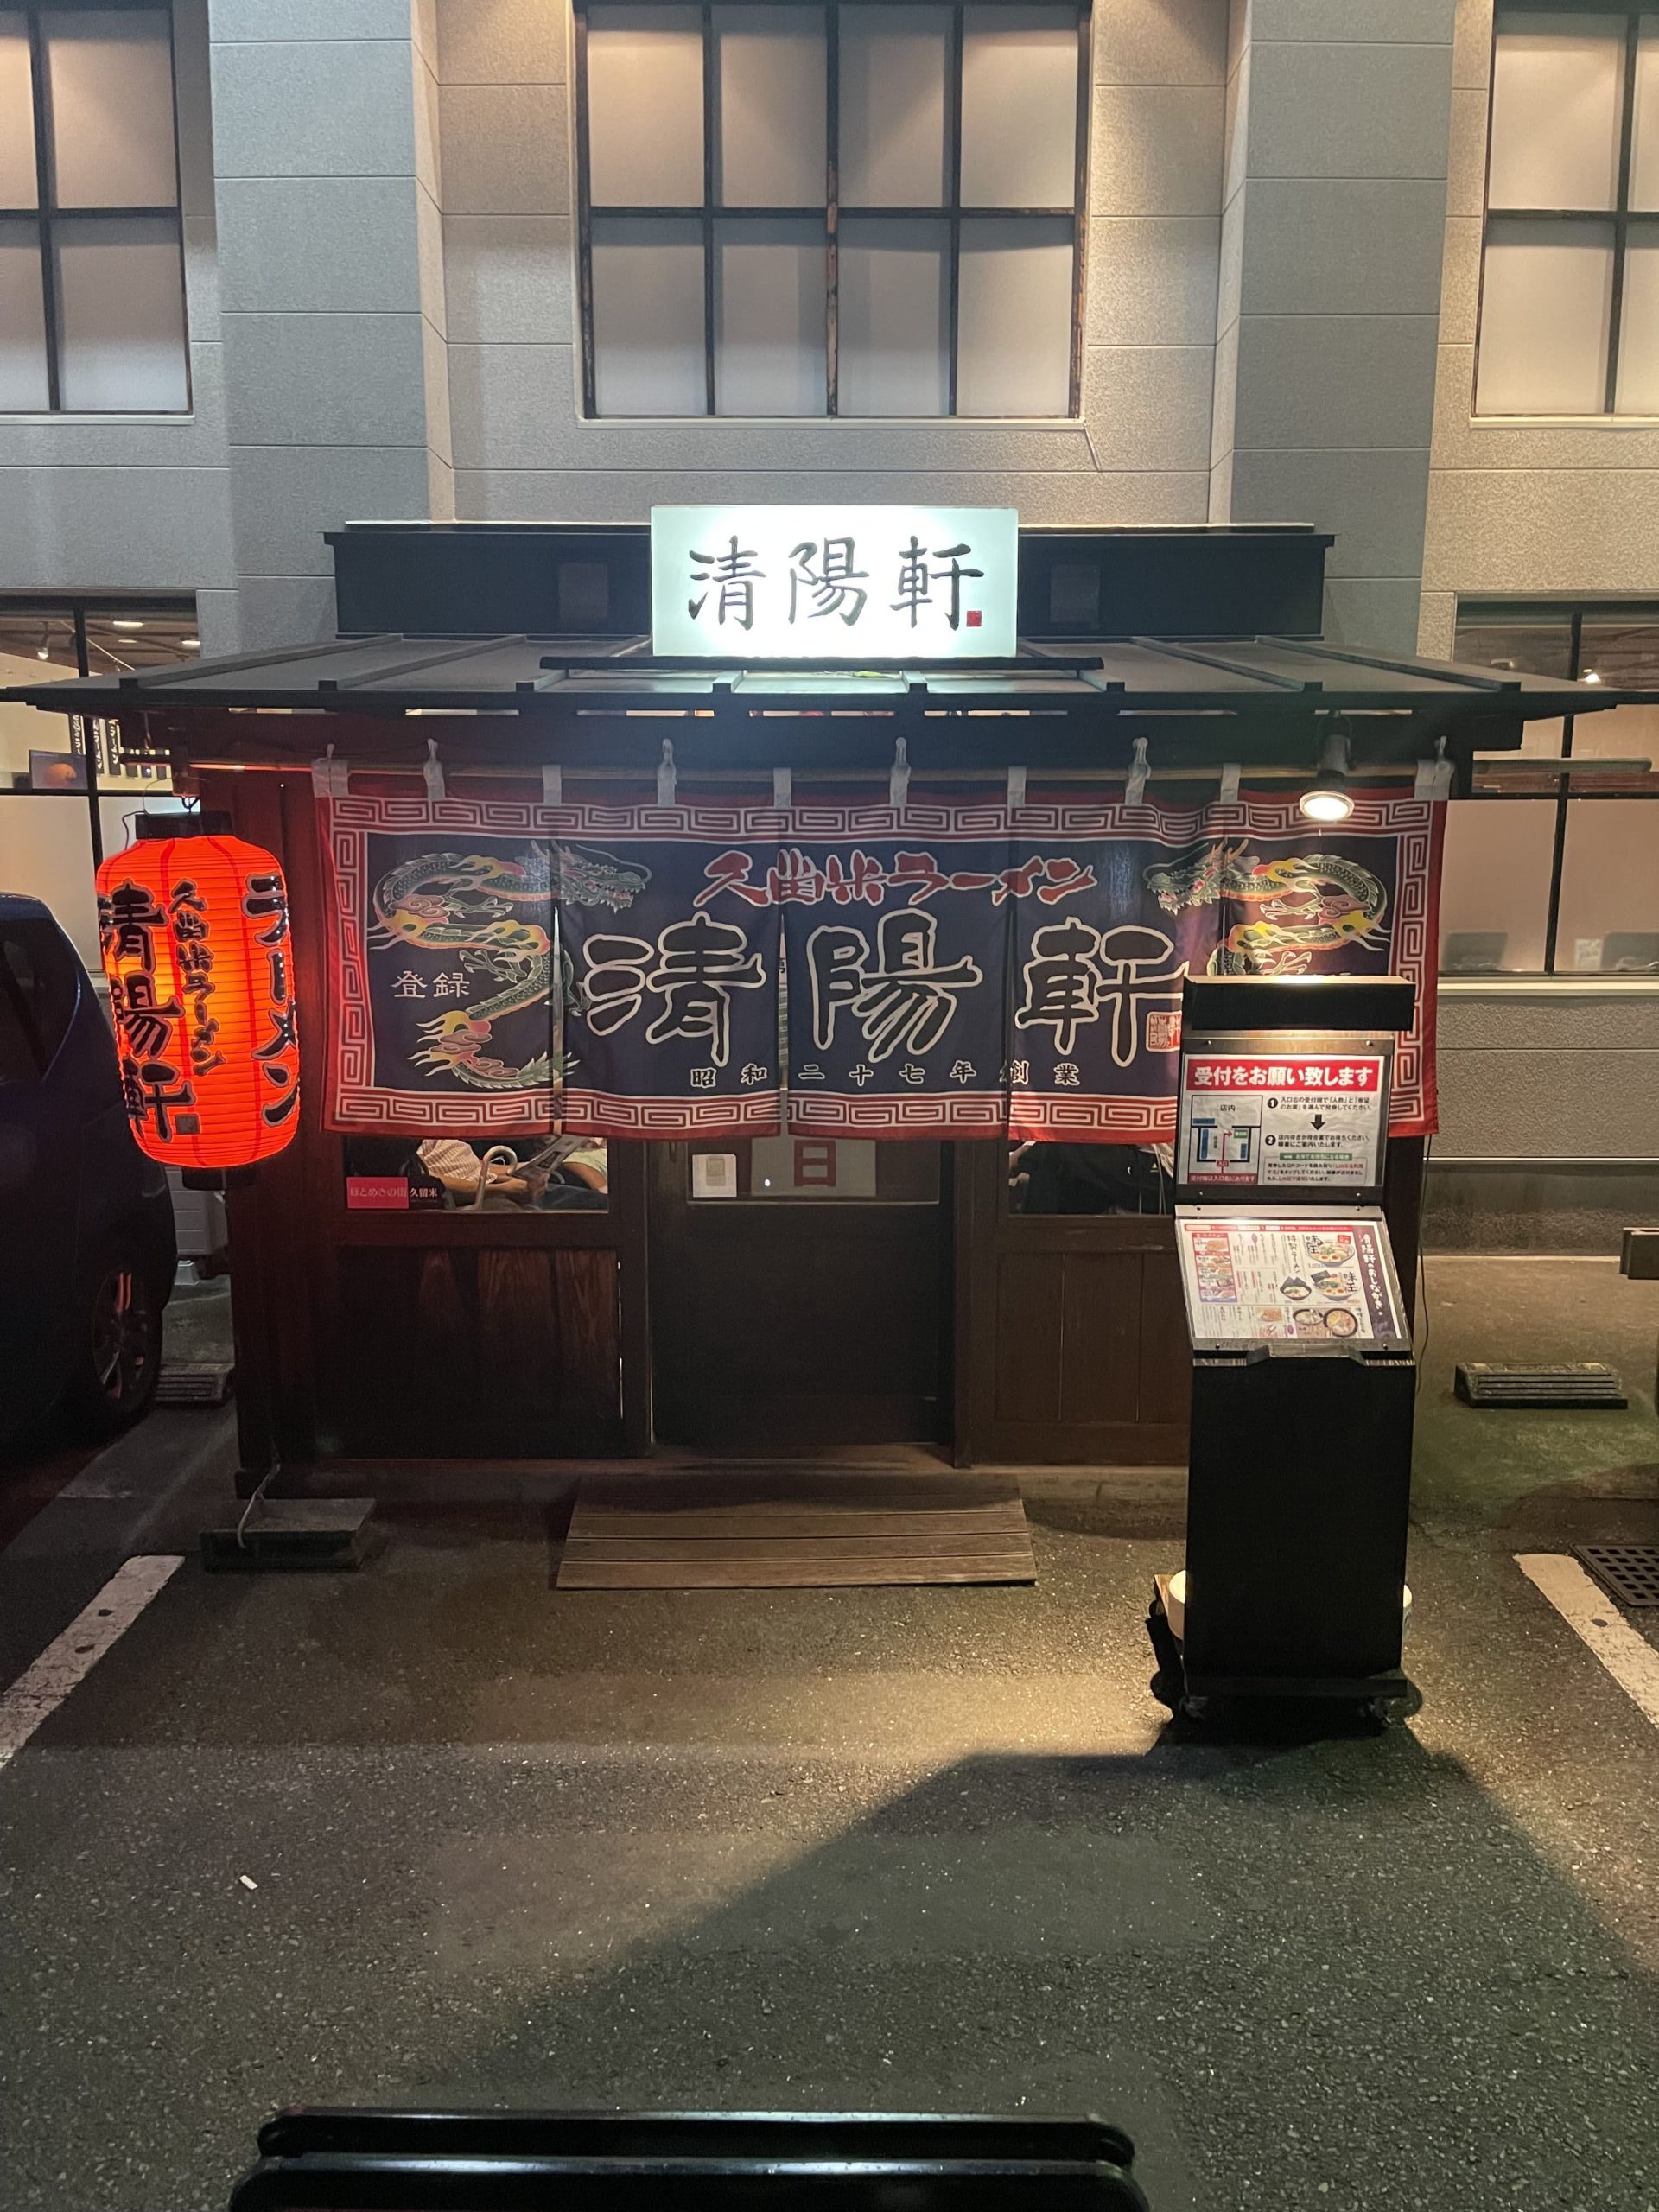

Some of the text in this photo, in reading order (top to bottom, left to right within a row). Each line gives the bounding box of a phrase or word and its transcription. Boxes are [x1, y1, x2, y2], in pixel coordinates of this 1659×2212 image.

[689, 535, 984, 631] 清陽軒
[693, 848, 1097, 906] 久留米ラーメン
[97, 878, 196, 1143] 清陽軒
[170, 879, 226, 1077] 久留米ラーメン
[241, 873, 299, 1128] ラーメン
[390, 970, 470, 999] 登録
[582, 908, 1188, 1067] 清陽軒
[690, 1061, 1080, 1087] 昭和二十七年創業
[1194, 1066, 1373, 1087] 受付をお願い致します
[1343, 1271, 1357, 1292] 味王
